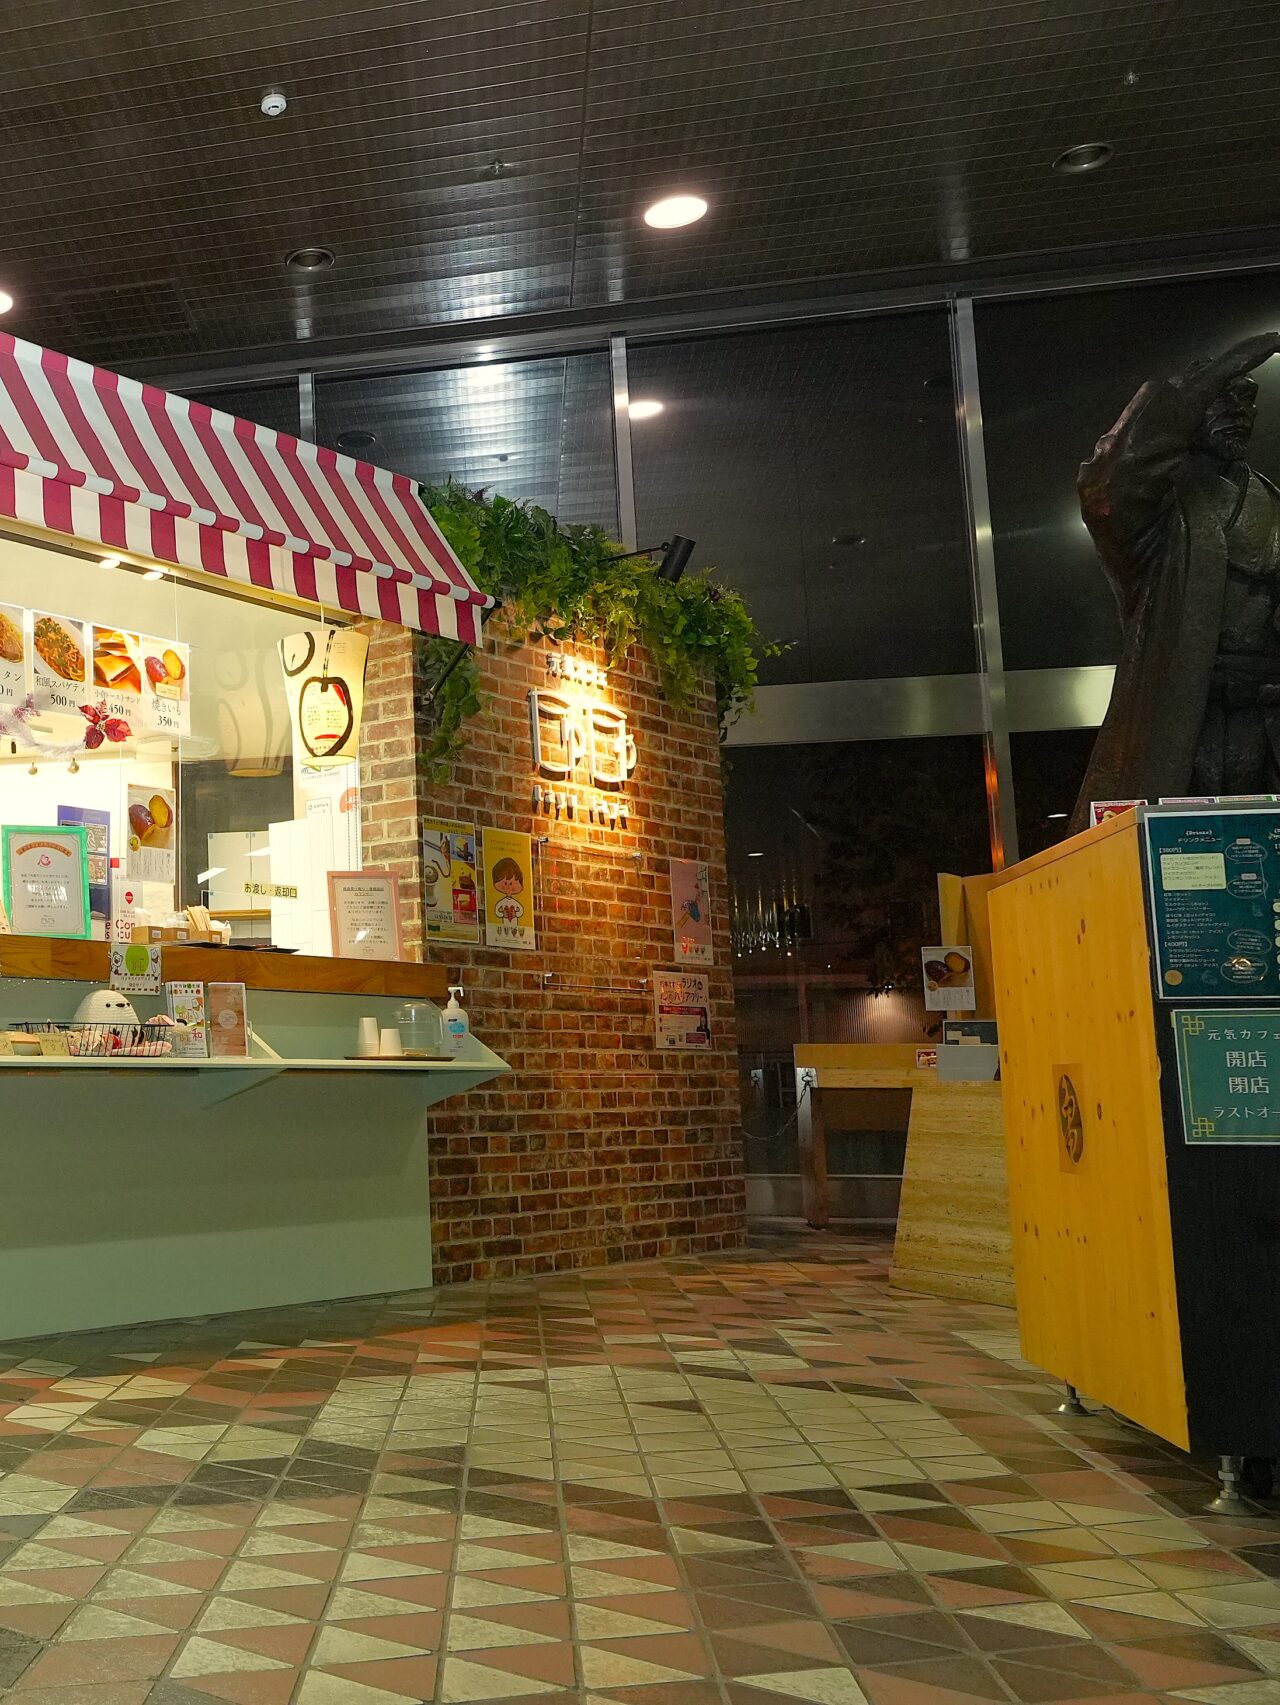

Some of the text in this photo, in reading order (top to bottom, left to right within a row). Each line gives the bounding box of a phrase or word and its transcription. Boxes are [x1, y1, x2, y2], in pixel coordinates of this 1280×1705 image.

[152, 698, 182, 716] 焼きいも
[244, 883, 297, 898] お渡し・返却口
[1207, 1028, 1280, 1041] 元気カフェ
[1226, 1050, 1268, 1068] 開店
[1228, 1076, 1270, 1094] 閉店
[1212, 1106, 1280, 1119] ラストオー
